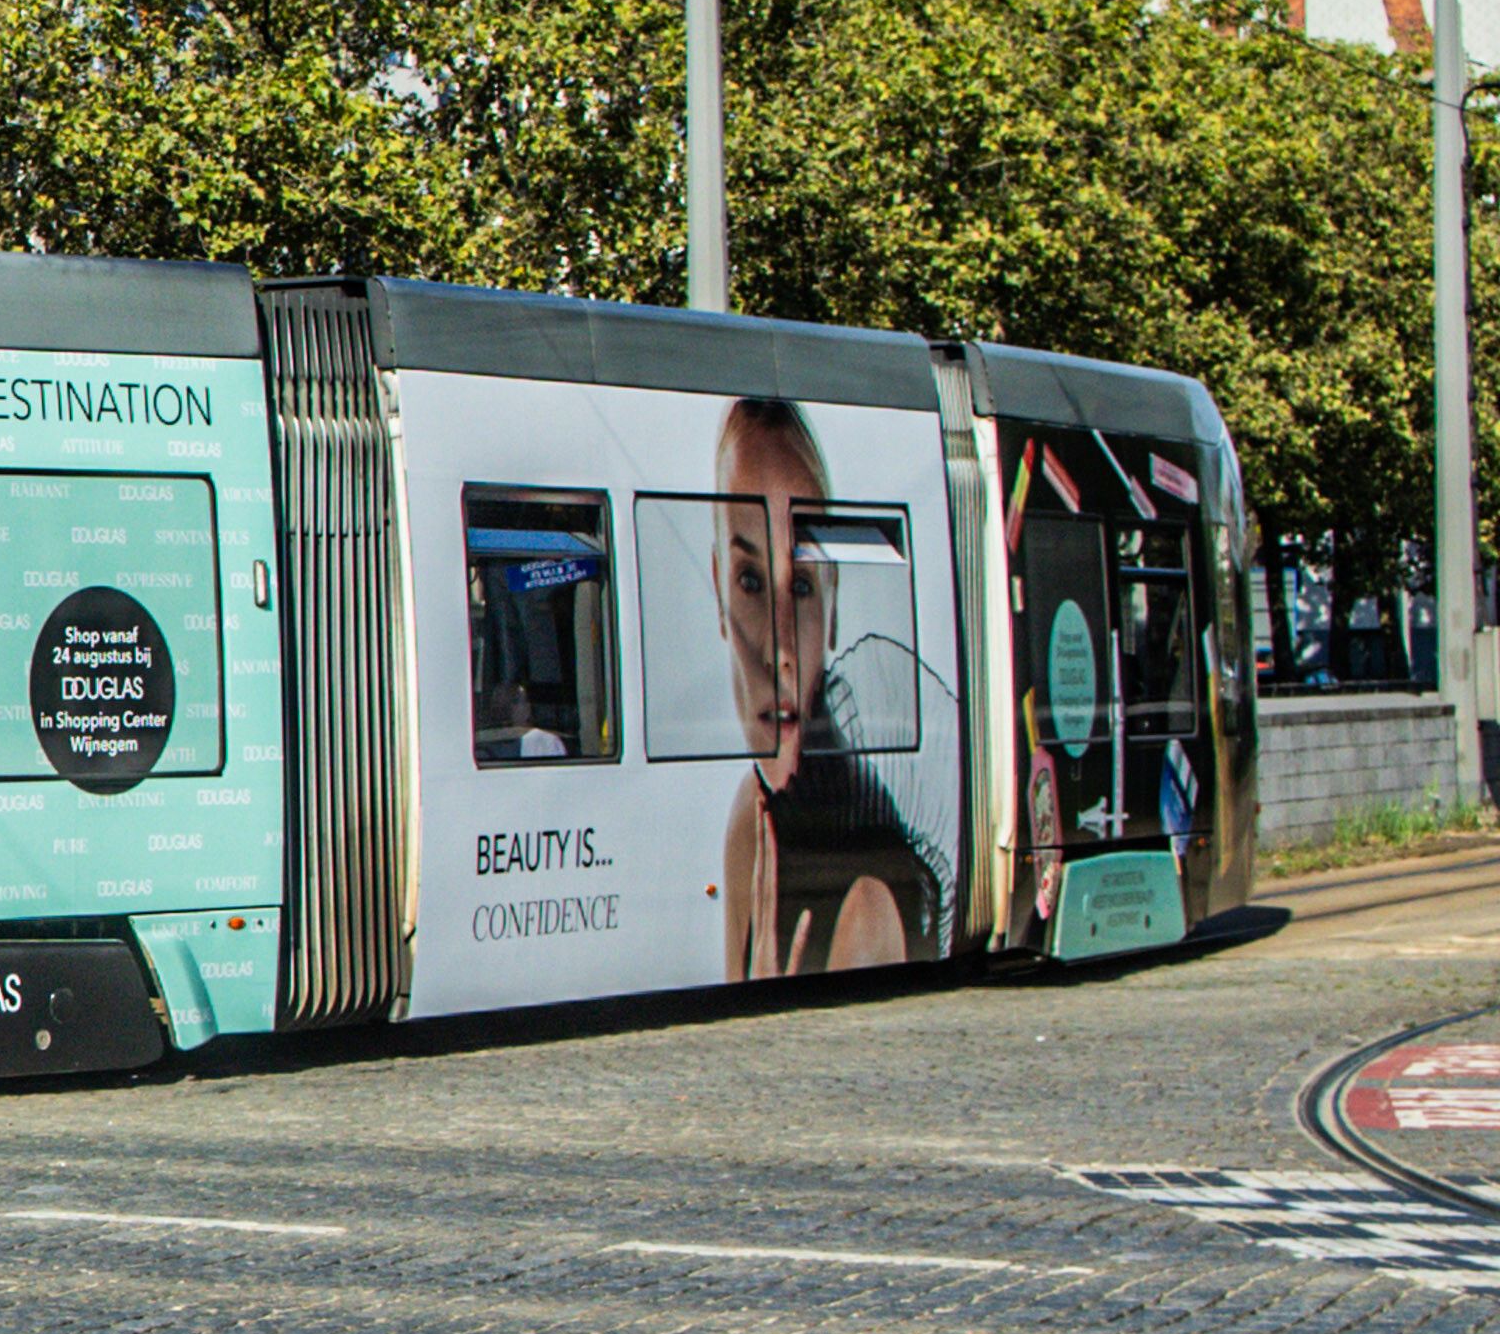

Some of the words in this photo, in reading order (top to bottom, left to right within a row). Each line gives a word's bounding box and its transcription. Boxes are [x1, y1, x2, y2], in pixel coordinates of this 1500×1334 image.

[60, 438, 125, 455] ATTITUDE
[167, 440, 222, 458] DOUGLAS
[11, 482, 71, 498] RADIANT
[119, 484, 174, 501] DOUGLAS
[71, 527, 127, 544] DOUGLAS
[23, 571, 79, 588] DOUGLAS
[116, 572, 193, 588] EXPRESSIVE
[65, 625, 100, 648] Shop
[102, 625, 140, 644] vanaf
[52, 647, 70, 665] 24
[73, 648, 132, 669] augustus
[135, 647, 152, 669] bij
[61, 676, 144, 701] DOUGLAS
[40, 711, 53, 729] in
[56, 711, 120, 733] Shopping
[122, 710, 168, 728] Center
[70, 735, 138, 757] Wijnegem
[196, 788, 252, 806] DOUGLAS
[53, 838, 89, 854] PURE
[148, 834, 204, 852] DOUGLAS
[476, 829, 571, 876] BEAUTY
[575, 827, 613, 868] IS...
[97, 879, 153, 898] DOUGLAS
[195, 874, 259, 892] COMFORT
[472, 894, 620, 942] CONFIDENCE
